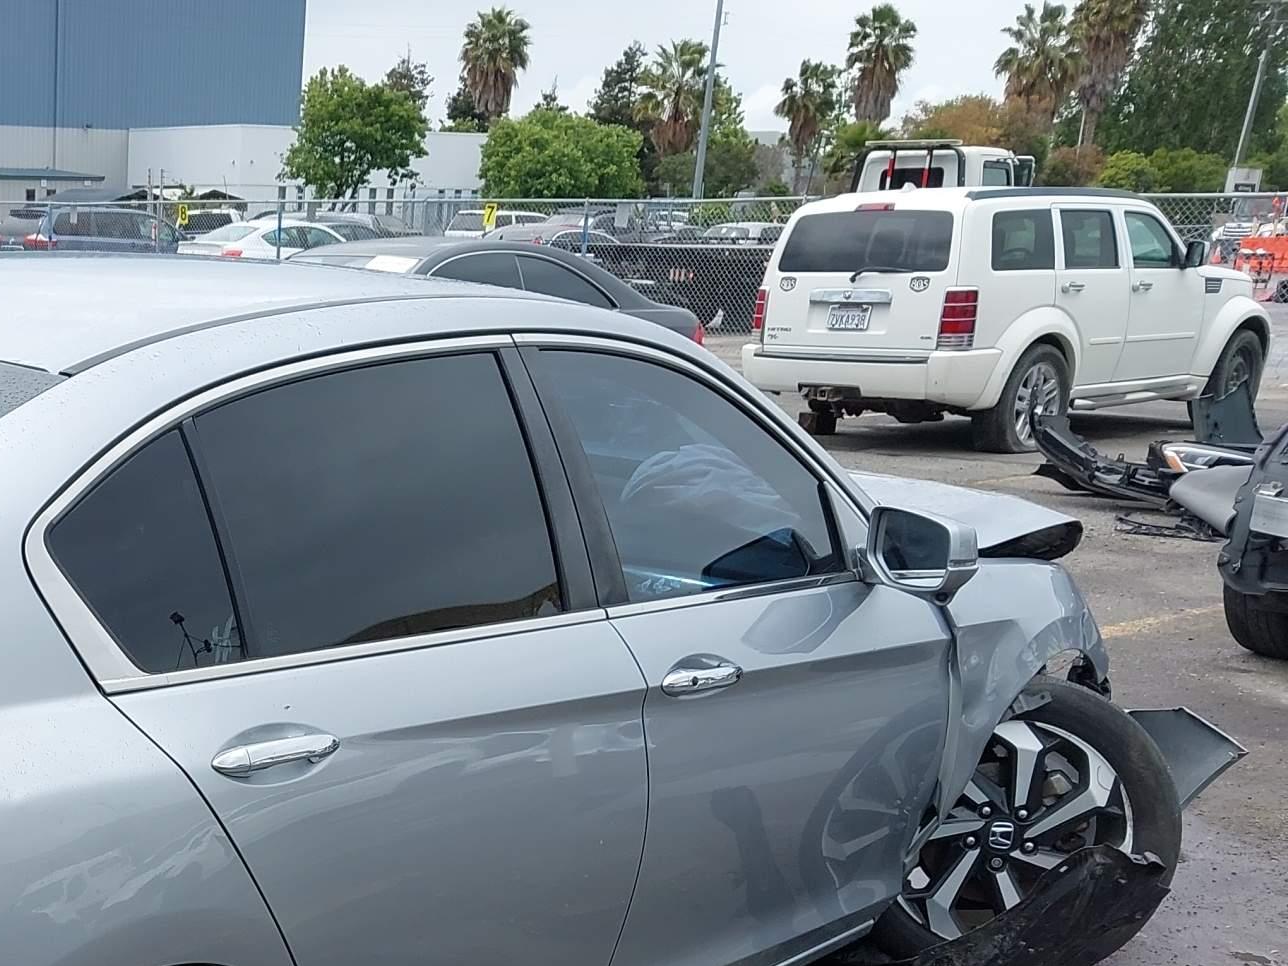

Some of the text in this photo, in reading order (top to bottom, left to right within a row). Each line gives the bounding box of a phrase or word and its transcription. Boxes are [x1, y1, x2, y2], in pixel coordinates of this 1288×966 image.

[180, 205, 187, 221] 8
[486, 205, 495, 223] 7
[911, 278, 929, 290] 805
